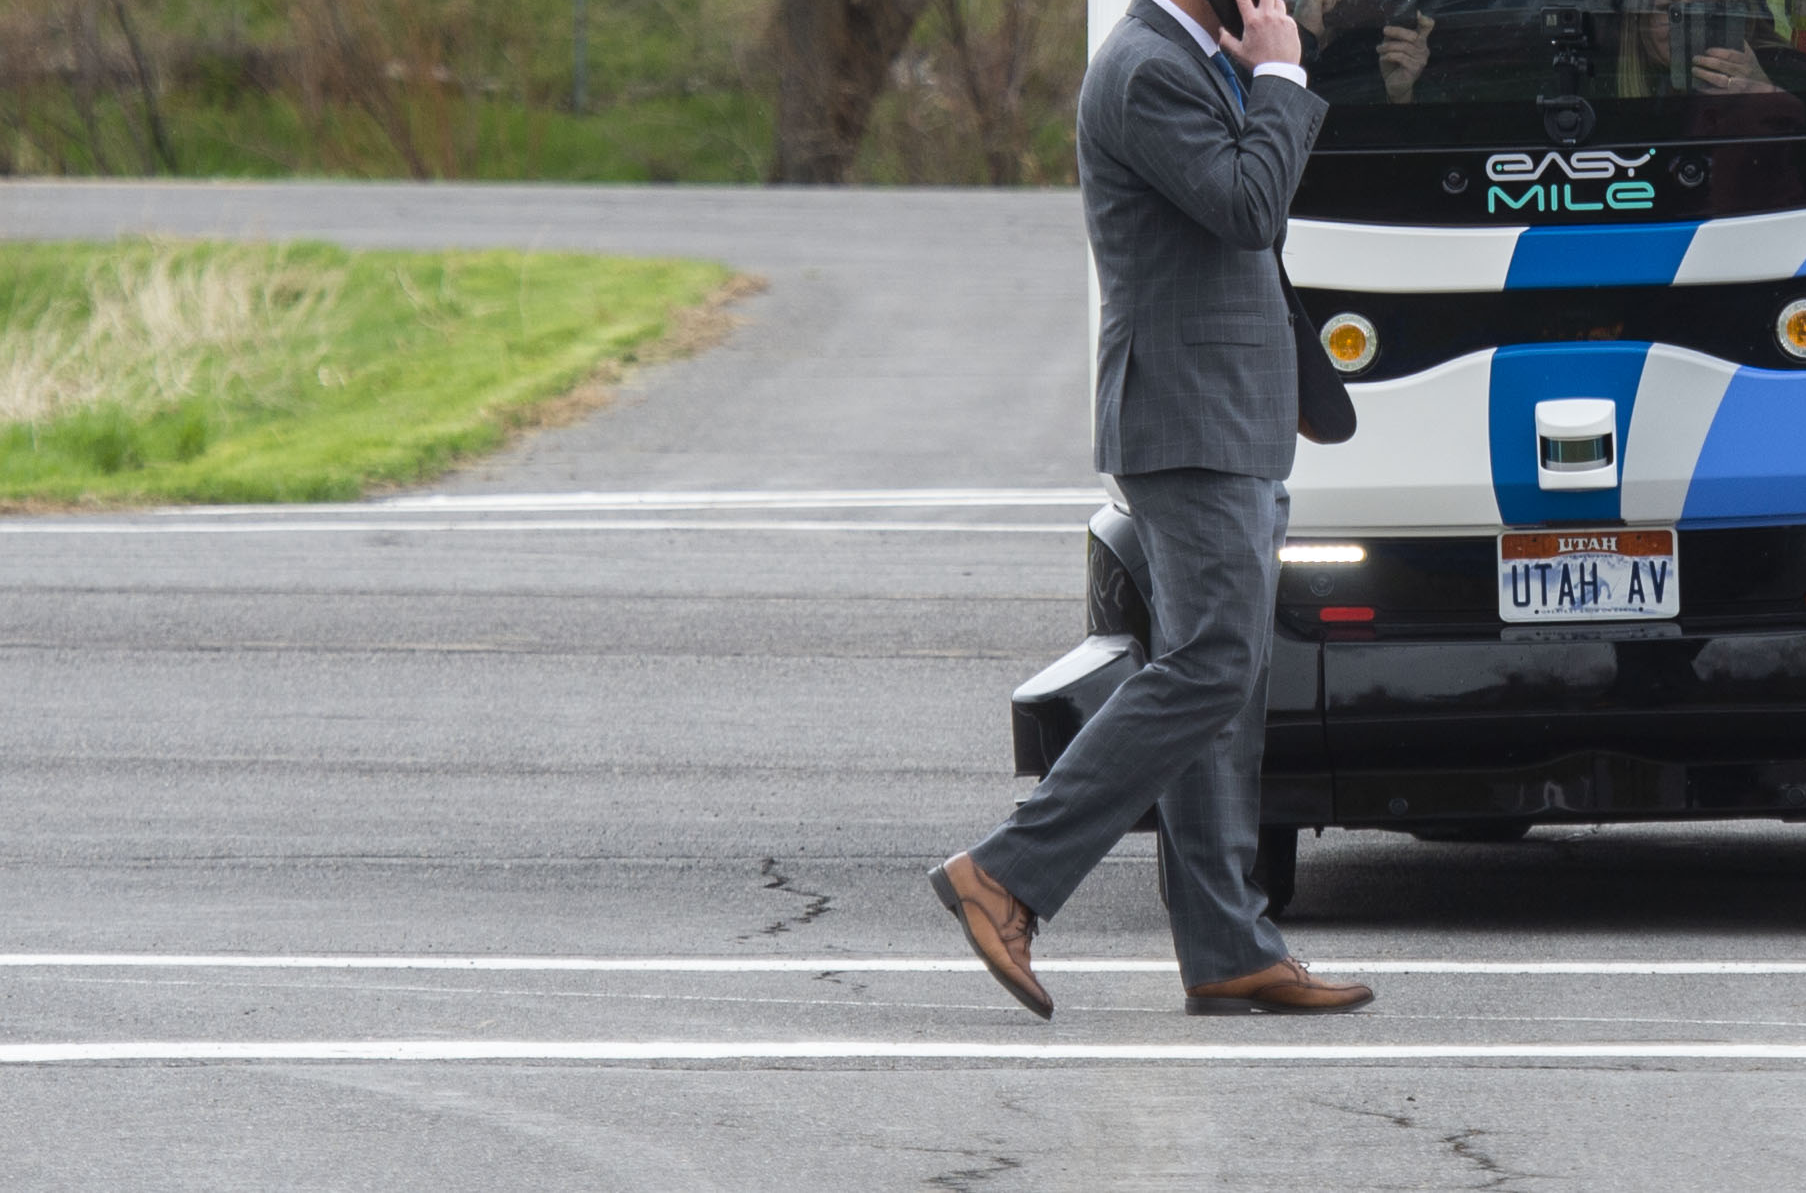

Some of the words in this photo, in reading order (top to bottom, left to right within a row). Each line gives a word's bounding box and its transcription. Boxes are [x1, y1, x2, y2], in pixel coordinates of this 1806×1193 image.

[1558, 537, 1618, 552] UTAH
[1512, 561, 1598, 607] UTAH
[1628, 561, 1667, 604] AV
